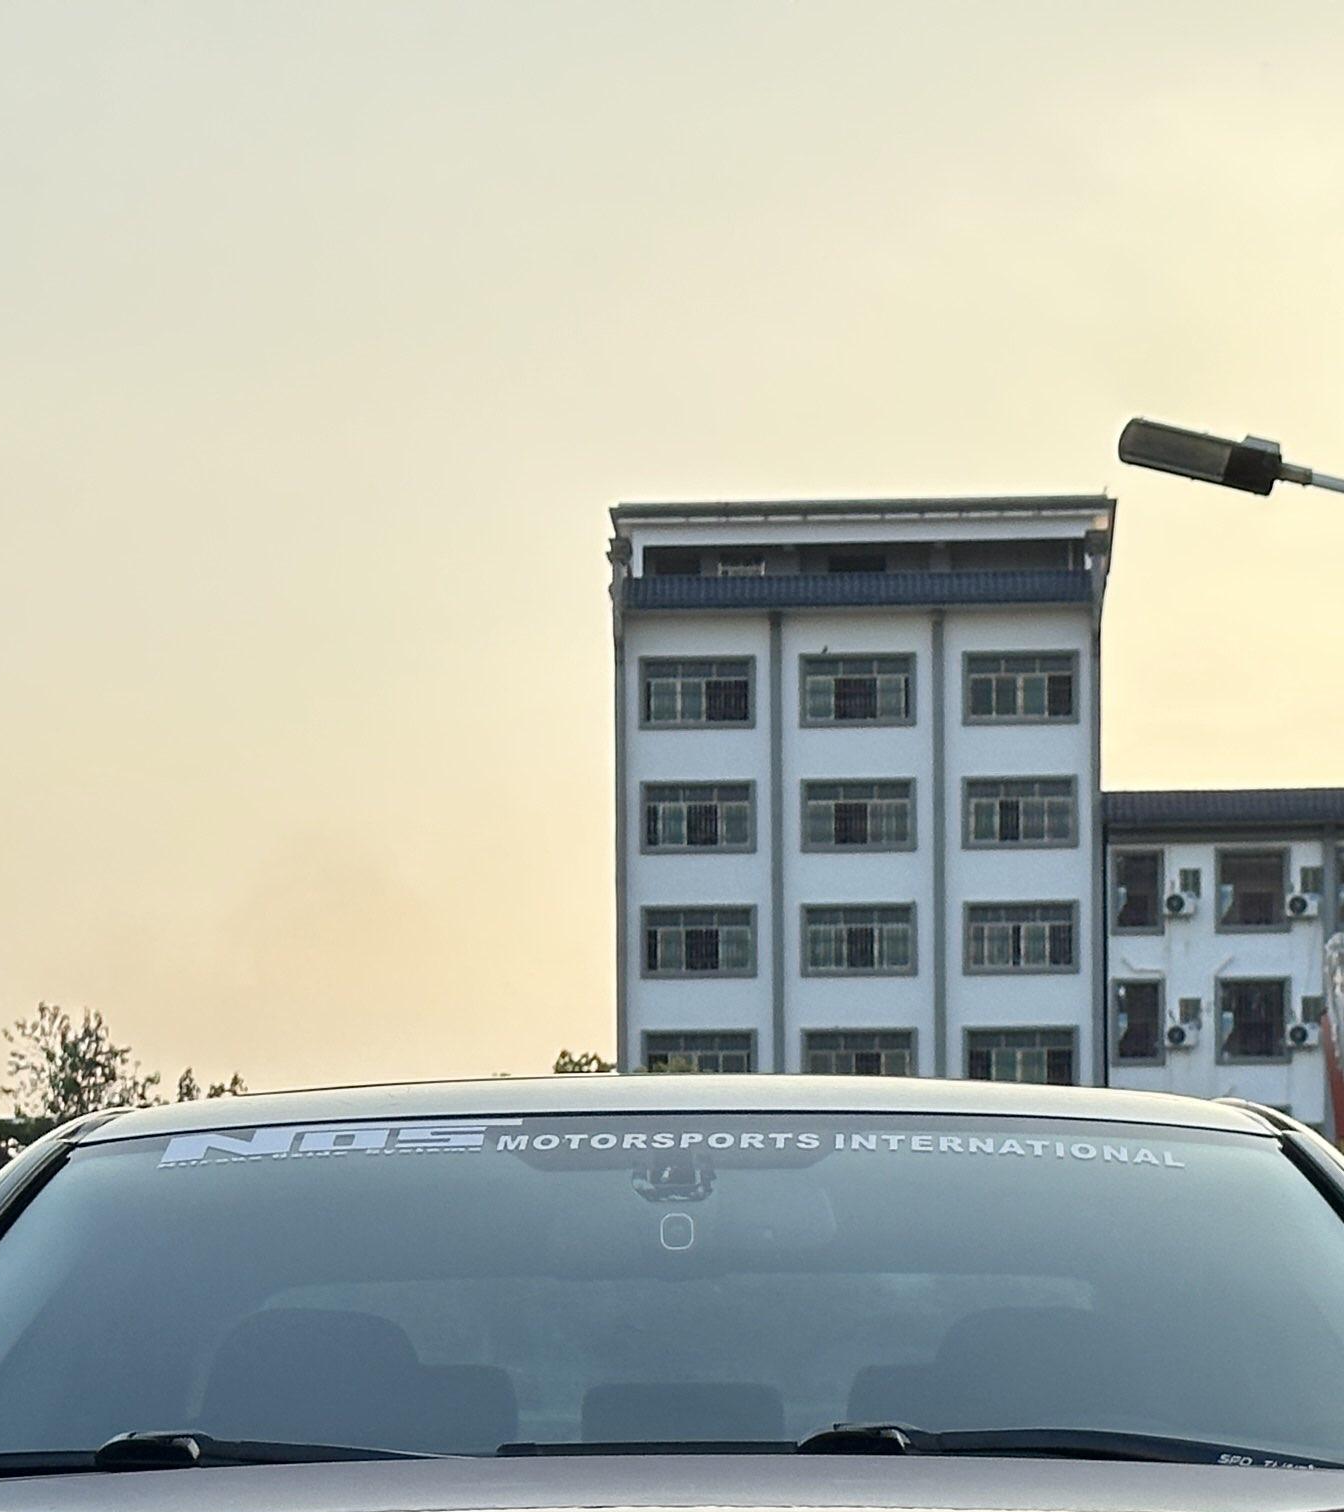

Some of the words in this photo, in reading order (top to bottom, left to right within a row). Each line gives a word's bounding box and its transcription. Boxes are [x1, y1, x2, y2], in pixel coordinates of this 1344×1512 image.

[160, 1118, 522, 1163] NOS
[497, 1133, 821, 1151] MOTORSPORTS
[833, 1133, 1186, 1168] INTERNATIONAL
